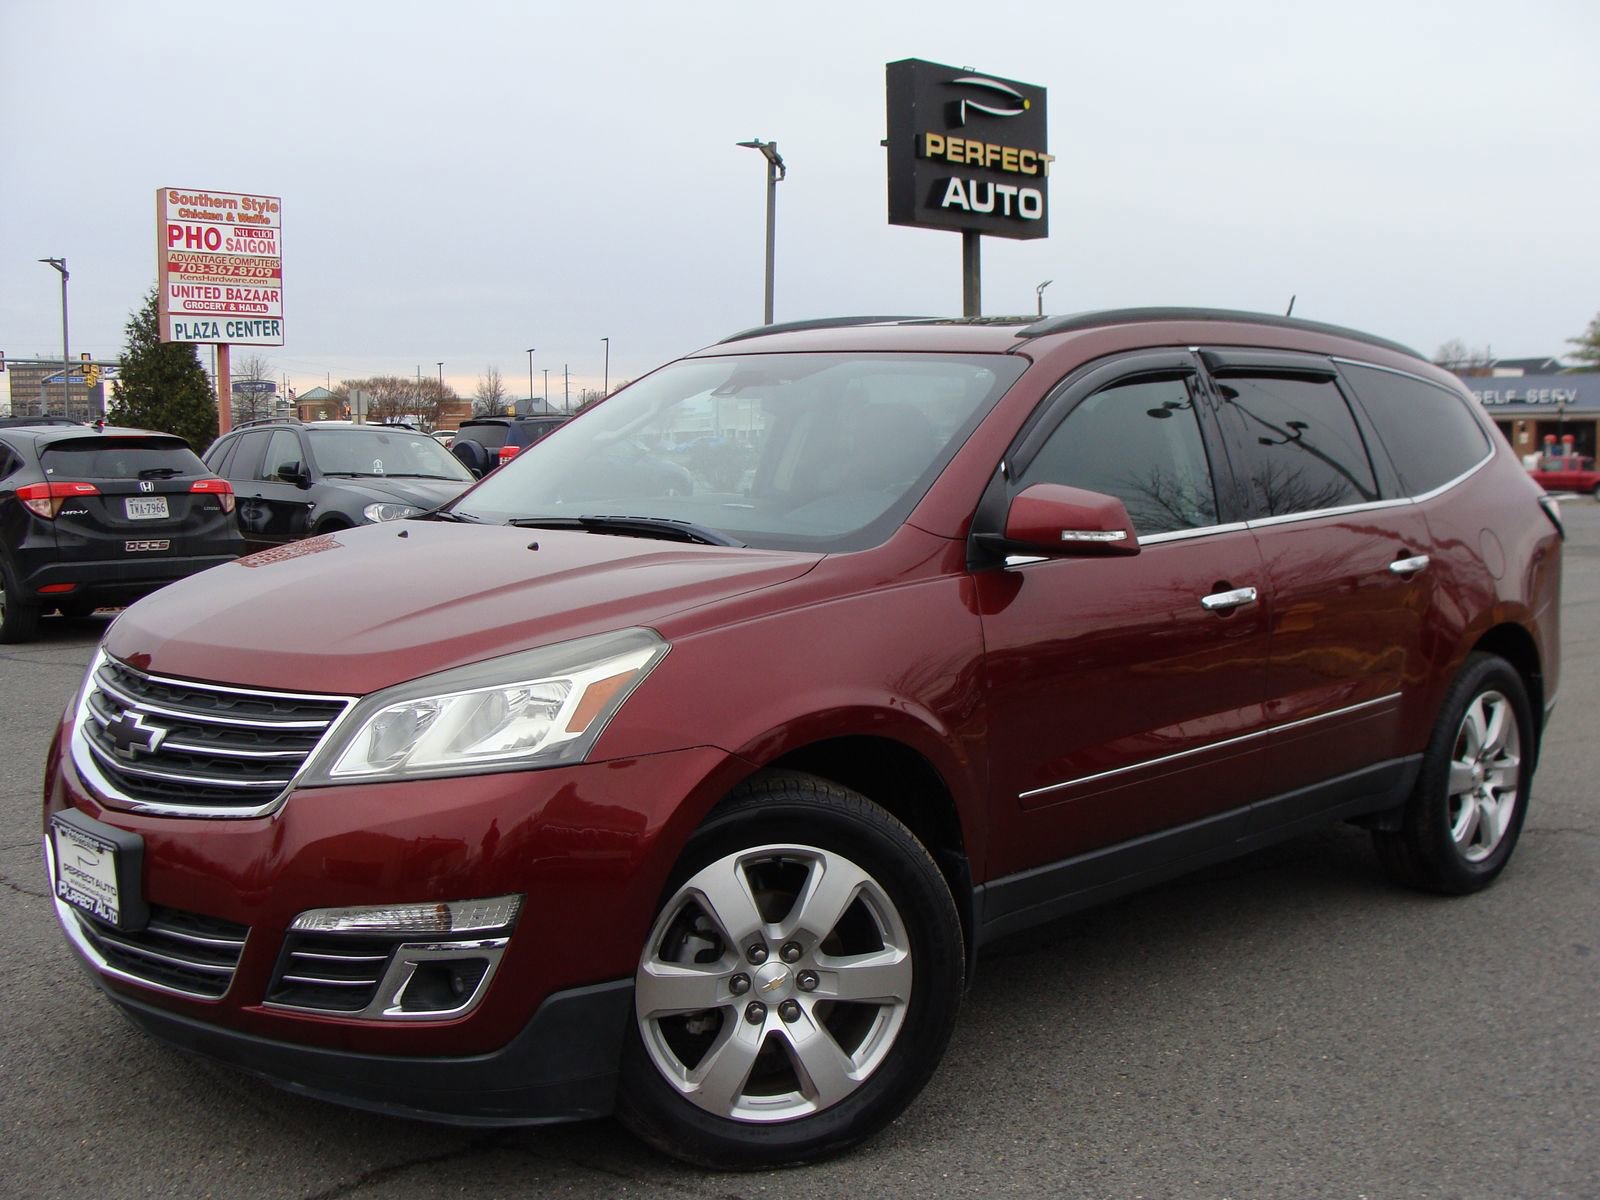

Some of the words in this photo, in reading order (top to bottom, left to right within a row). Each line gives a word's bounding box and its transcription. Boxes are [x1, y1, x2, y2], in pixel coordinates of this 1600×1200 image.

[925, 132, 1055, 177] PERFECT
[169, 190, 238, 210] Southern
[241, 197, 279, 217] Style
[941, 176, 1043, 220] AUTO
[178, 208, 223, 222] Chicken
[226, 212, 235, 223] &
[237, 212, 271, 225] Waffle
[168, 224, 222, 251] PHO
[225, 237, 276, 255] SAIGON
[170, 253, 227, 265] ADVANTAGE
[228, 256, 280, 268] COMPUTERS
[179, 263, 273, 277] 703-367-8709
[180, 273, 268, 285] KensHardware.com
[171, 285, 221, 299] UNITED
[226, 288, 279, 303] BAZAAR
[185, 300, 227, 311] GROCERY
[229, 303, 236, 311] &
[238, 303, 267, 312] HALAL
[175, 321, 220, 340] PLAZA
[226, 320, 281, 338] CENTER
[1525, 388, 1577, 404] SERV
[64, 863, 95, 884] PERFECT
[96, 880, 117, 897] AUTO
